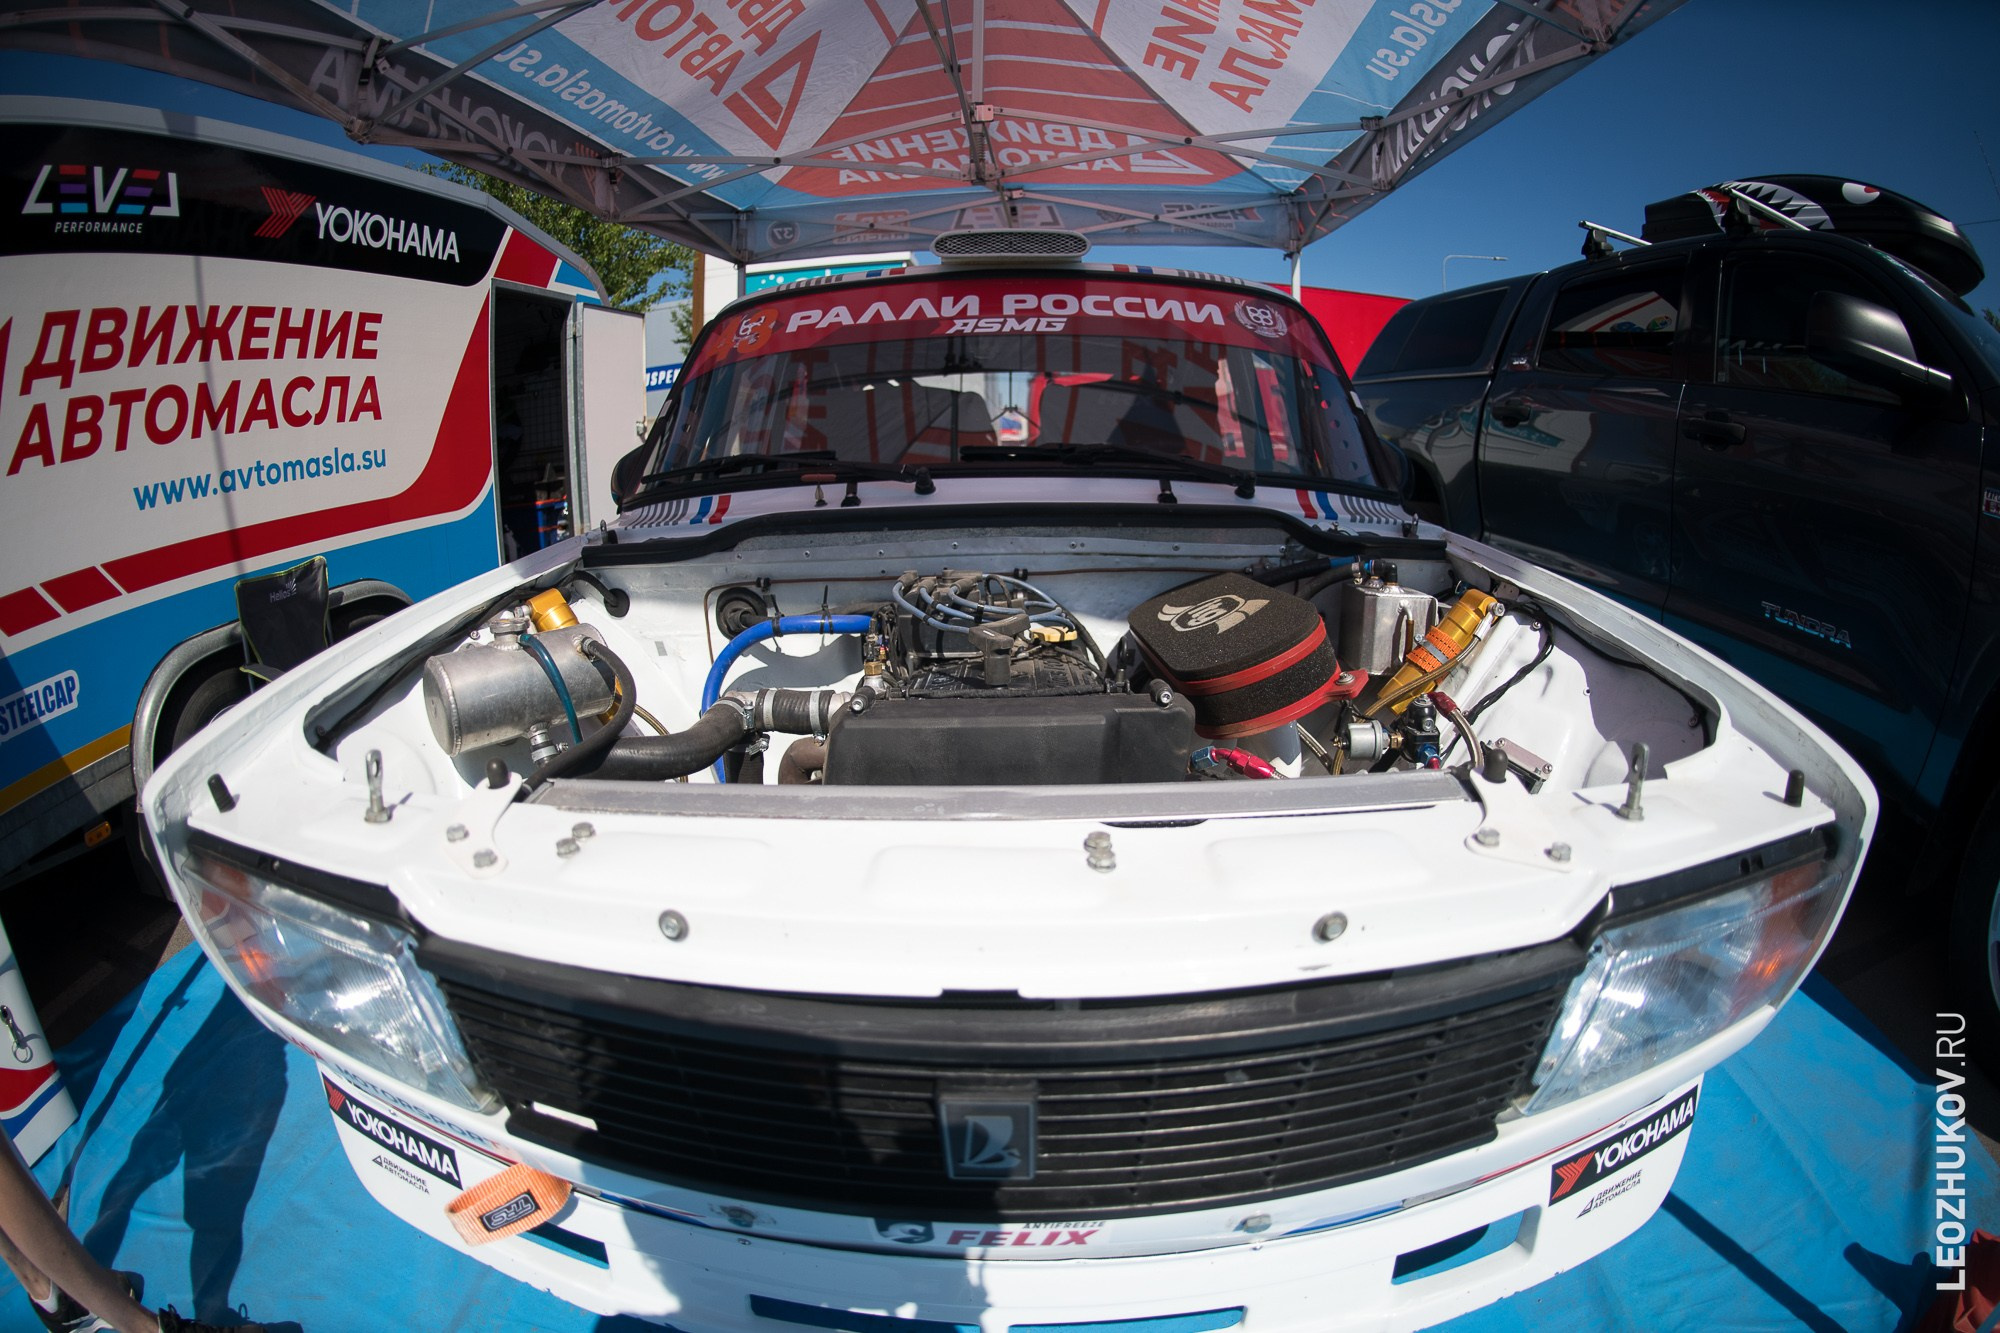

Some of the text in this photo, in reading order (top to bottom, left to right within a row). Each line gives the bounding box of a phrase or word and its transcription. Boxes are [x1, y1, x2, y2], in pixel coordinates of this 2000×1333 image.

[54, 221, 144, 234] PERFORMANCE
[316, 202, 460, 263] YOKOHAMA
[19, 304, 383, 396] ДВИЖЕНИЕ
[5, 374, 383, 476] АВТОМАСЛА
[133, 444, 387, 511] www.avtomasla.su
[1761, 600, 1852, 649] TUNDRA
[0, 675, 76, 736] STEELCAP
[345, 1099, 460, 1182] YOKOHAMA
[1594, 1096, 1694, 1174] YOKOHAMA
[382, 1156, 427, 1187] ДВИЖЕНИЕ
[382, 1164, 431, 1195] АВТОМАСЛА
[1593, 1178, 1642, 1210] АВТОМАСЛА
[1595, 1169, 1642, 1201] ДВИЖЕНИЕ
[946, 1229, 1100, 1246] FELIX
[1023, 1220, 1107, 1229] ANTIFREEZE
